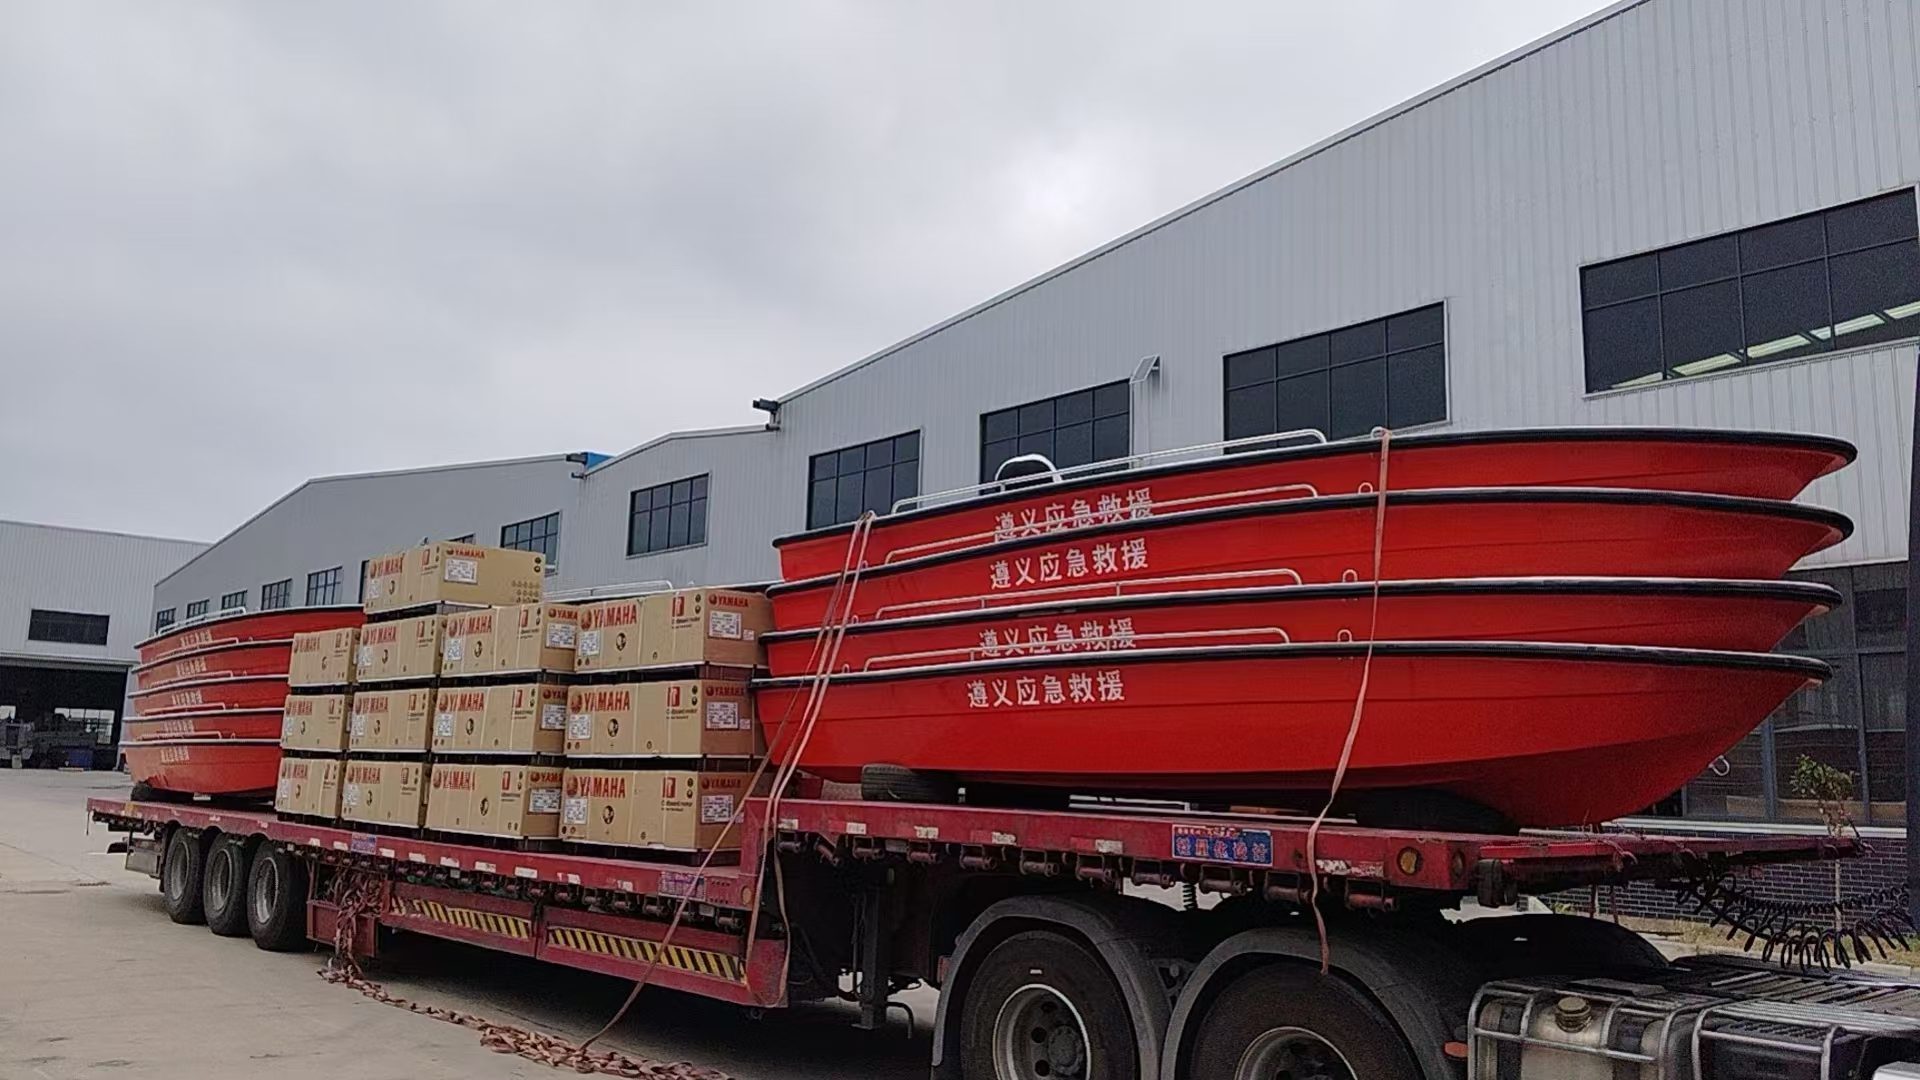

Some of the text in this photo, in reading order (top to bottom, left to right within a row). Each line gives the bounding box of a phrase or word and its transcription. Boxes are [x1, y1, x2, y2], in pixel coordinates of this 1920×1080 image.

[455, 547, 485, 559] YAMAHA
[989, 537, 1148, 590] 遵义应急救援
[717, 595, 749, 608] YAMAHA
[557, 609, 578, 620] YAMA
[593, 604, 637, 627] YAMAHA
[458, 615, 492, 636] YAMAHA
[979, 617, 1136, 658] 遵义应急救援
[714, 686, 744, 697] YAMAHA
[967, 669, 1125, 708] 遵义应急救援
[449, 692, 484, 712] YAMAHA
[584, 690, 630, 712] YAMAHA
[443, 770, 475, 791] YAMAHA
[541, 771, 562, 782] YAMA
[711, 778, 741, 788] YAMAHA
[580, 777, 626, 798] YAMAHA
